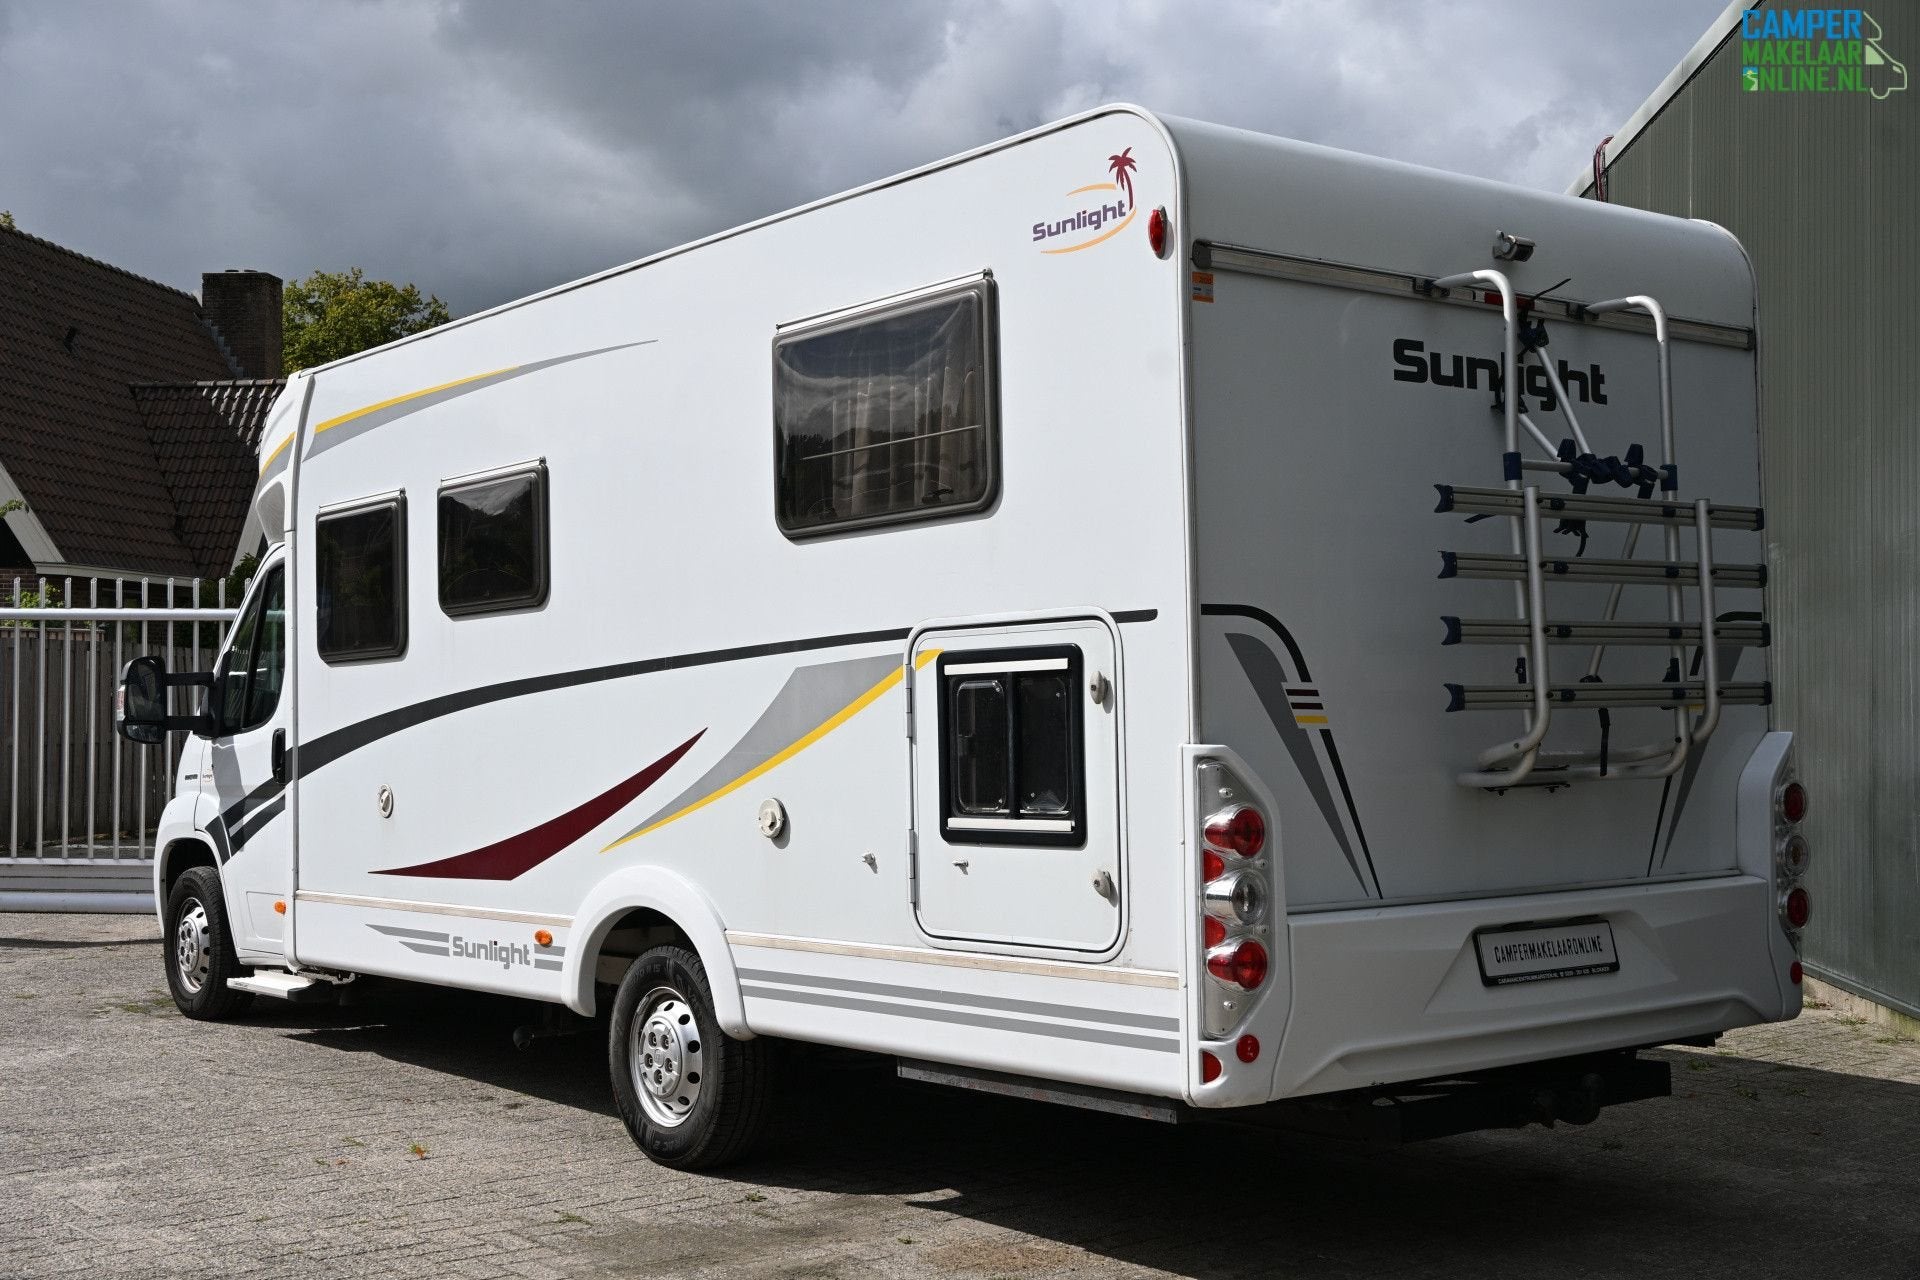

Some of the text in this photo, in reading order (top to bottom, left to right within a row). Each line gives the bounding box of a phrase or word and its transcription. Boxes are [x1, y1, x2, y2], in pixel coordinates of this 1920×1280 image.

[1032, 199, 1126, 242] Sunlight
[452, 936, 531, 970] Sunlight
[1494, 935, 1603, 964] CAMPERMAKELAARONLINE
